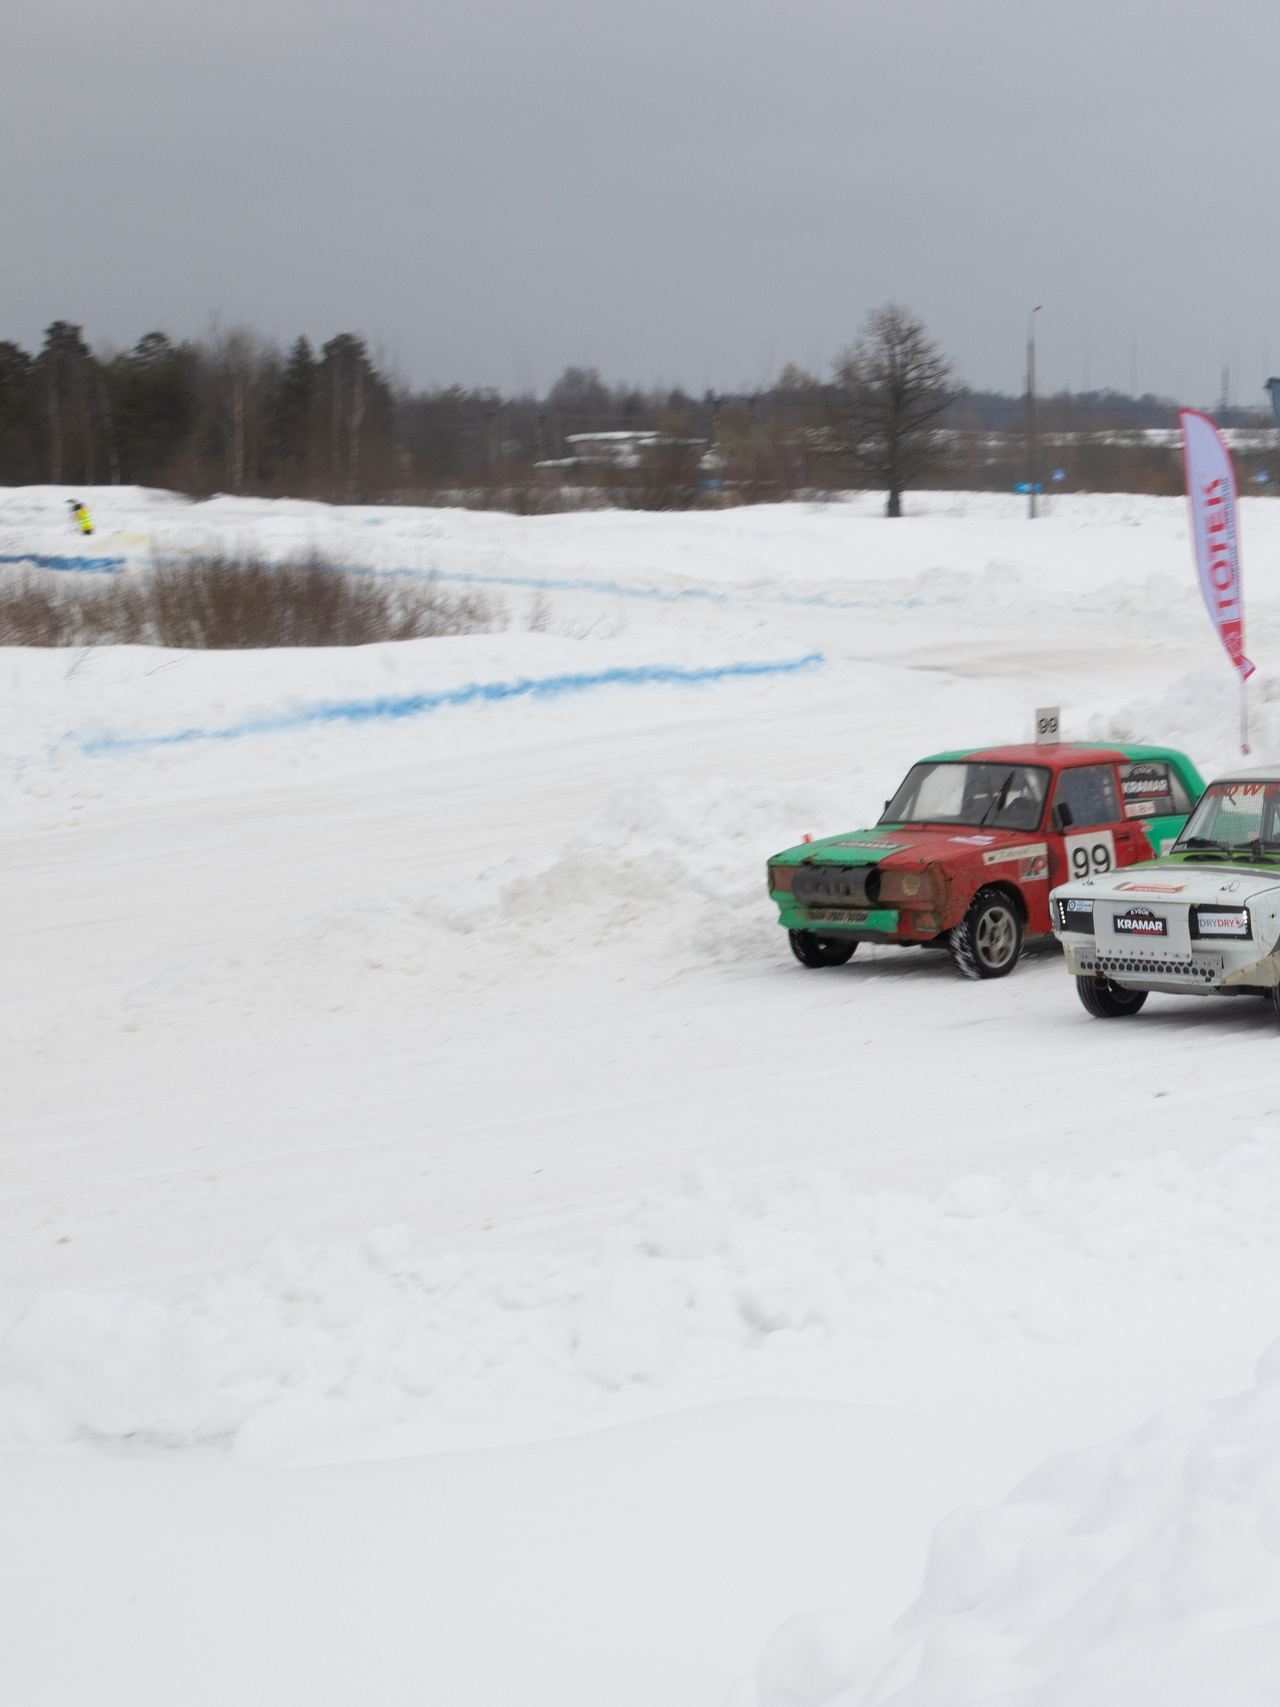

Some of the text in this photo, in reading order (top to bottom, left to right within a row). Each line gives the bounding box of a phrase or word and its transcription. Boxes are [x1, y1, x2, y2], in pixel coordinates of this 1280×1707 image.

[1039, 716, 1058, 734] 99
[1073, 844, 1110, 879] 99
[1117, 919, 1163, 931] KRAMAR
